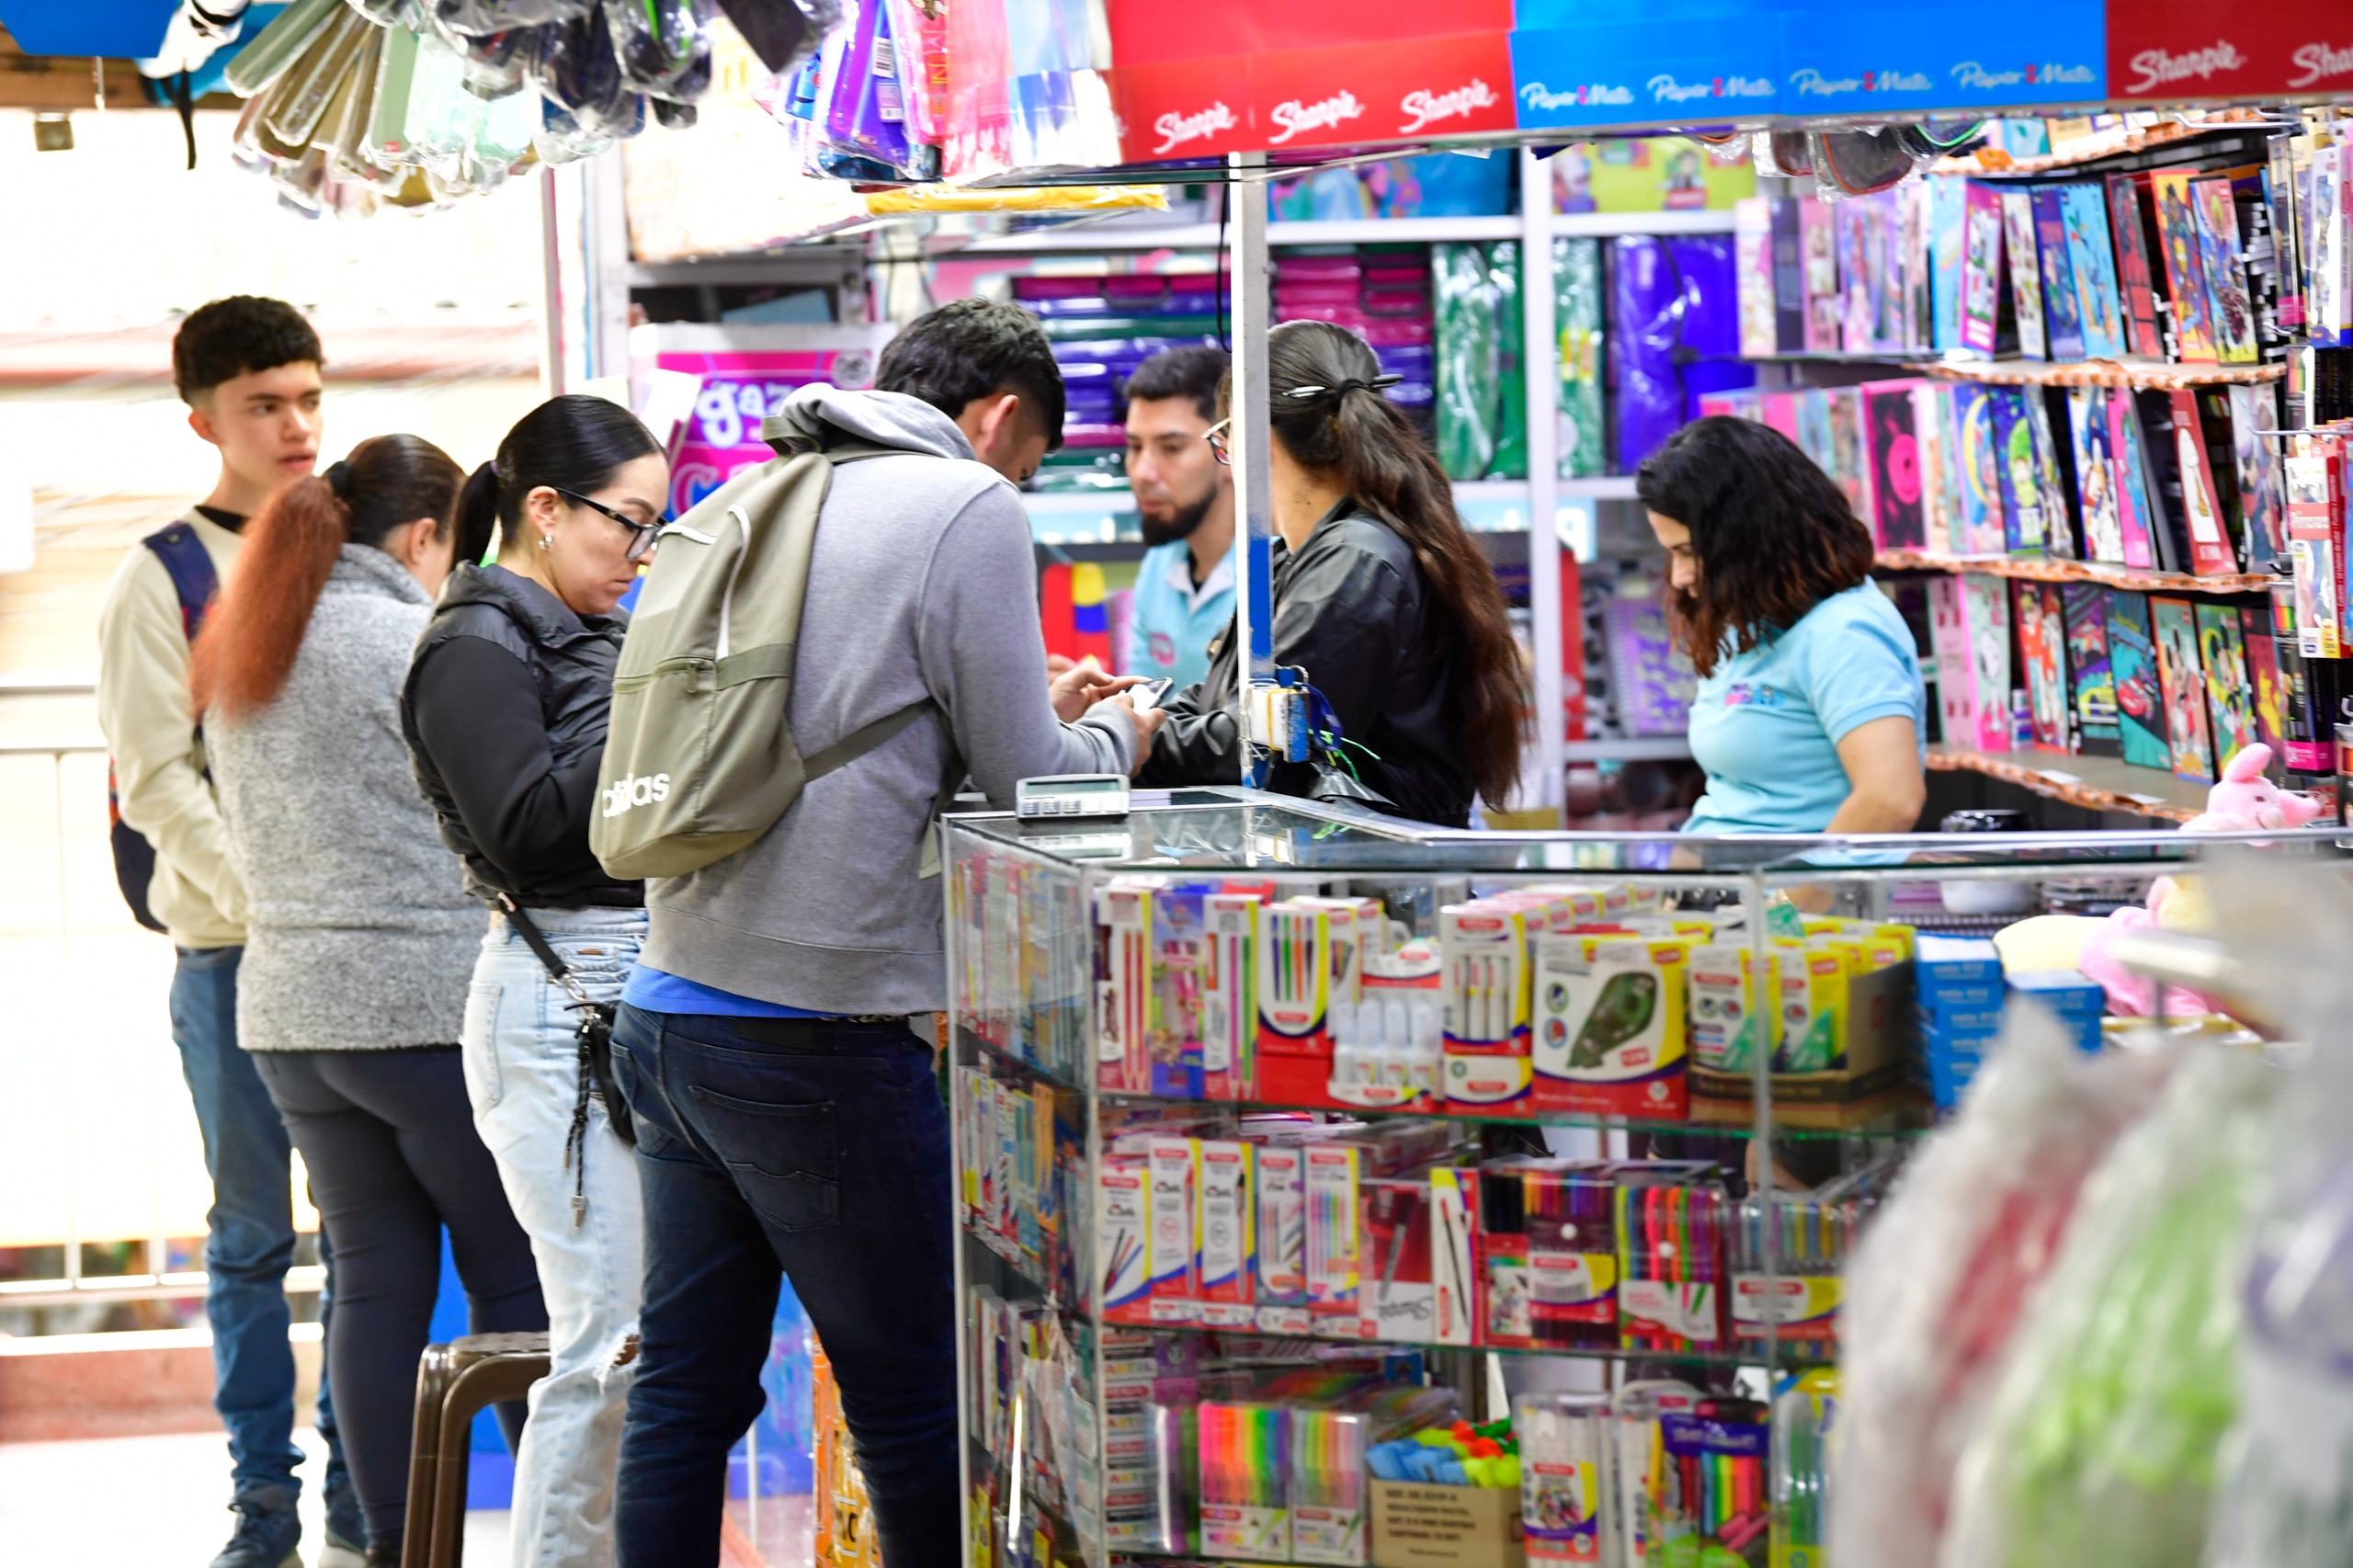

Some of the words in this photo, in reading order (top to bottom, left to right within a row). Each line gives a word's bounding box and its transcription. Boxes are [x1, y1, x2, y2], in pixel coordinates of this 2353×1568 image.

[1790, 69, 1861, 96] Paper
[1877, 70, 1933, 91] Mate
[1950, 62, 2024, 88] Paper
[2038, 63, 2096, 84] Mate
[2125, 39, 2248, 93] Sharpie
[1399, 78, 1499, 133] Sharpie
[1519, 82, 1577, 110] Paper
[1587, 84, 1634, 106] Mate
[1646, 74, 1711, 102] Paper
[1722, 76, 1776, 97] Mate
[1153, 101, 1238, 154] Sharpie
[1268, 89, 1366, 143] Sharpie
